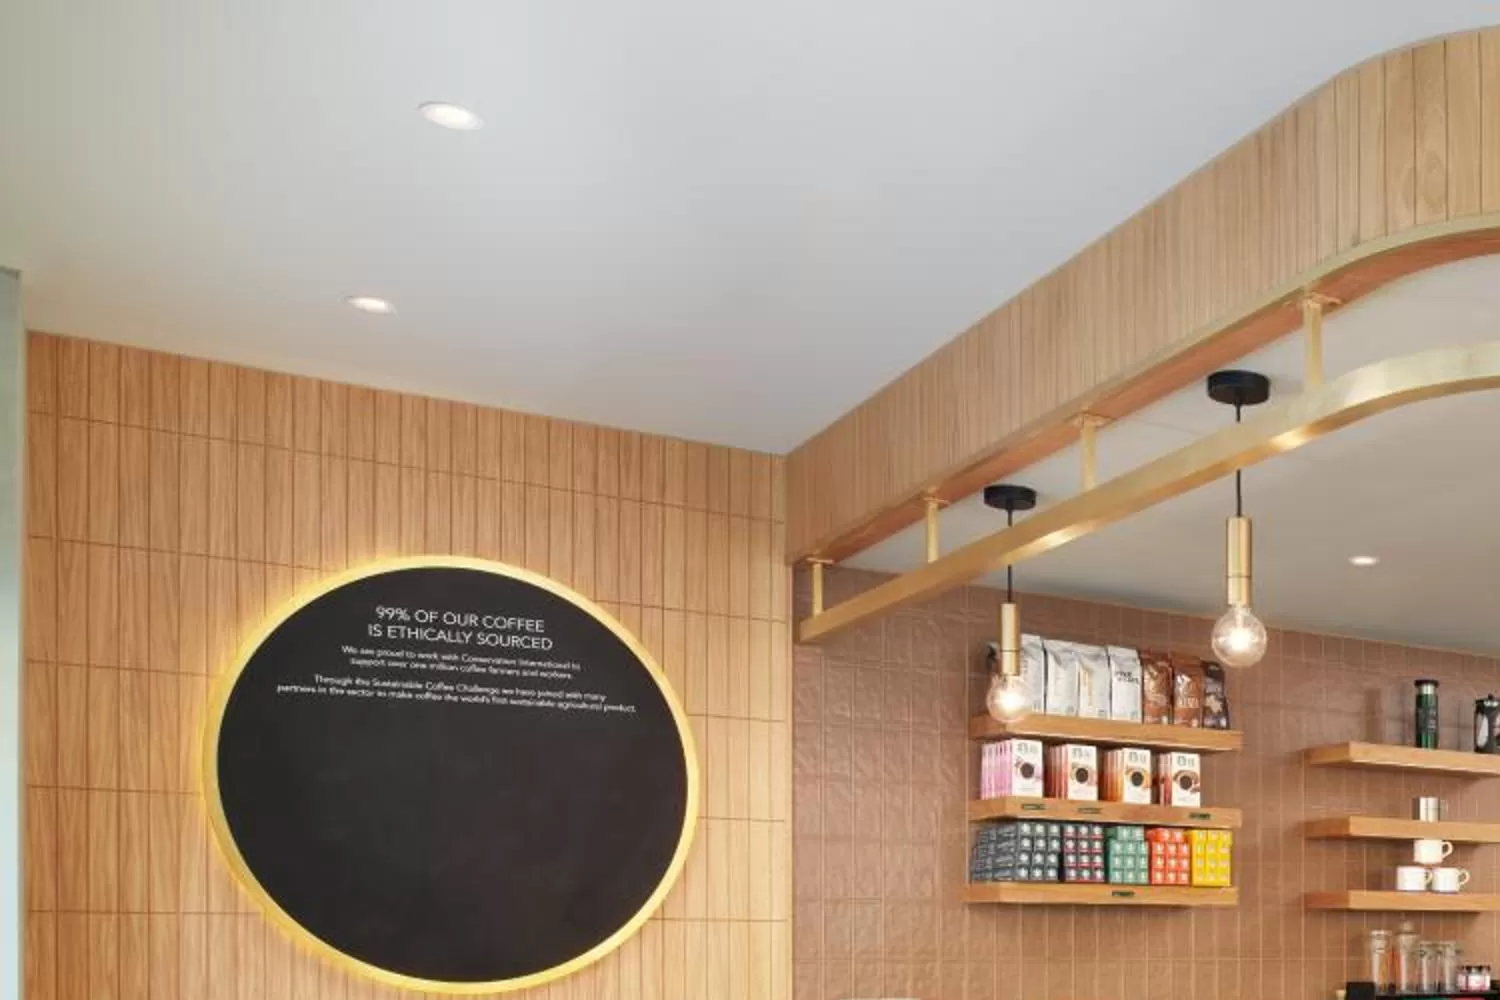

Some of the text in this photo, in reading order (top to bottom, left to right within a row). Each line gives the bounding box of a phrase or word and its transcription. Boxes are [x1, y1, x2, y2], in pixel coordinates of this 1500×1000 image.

[375, 605, 545, 633] 99% OF OUR COFFEE
[368, 623, 553, 651] IS ETHICALLY SOURCED
[376, 649, 404, 658] proud
[460, 663, 487, 673] coffee
[315, 673, 353, 686] Through
[425, 681, 455, 692] Coffee
